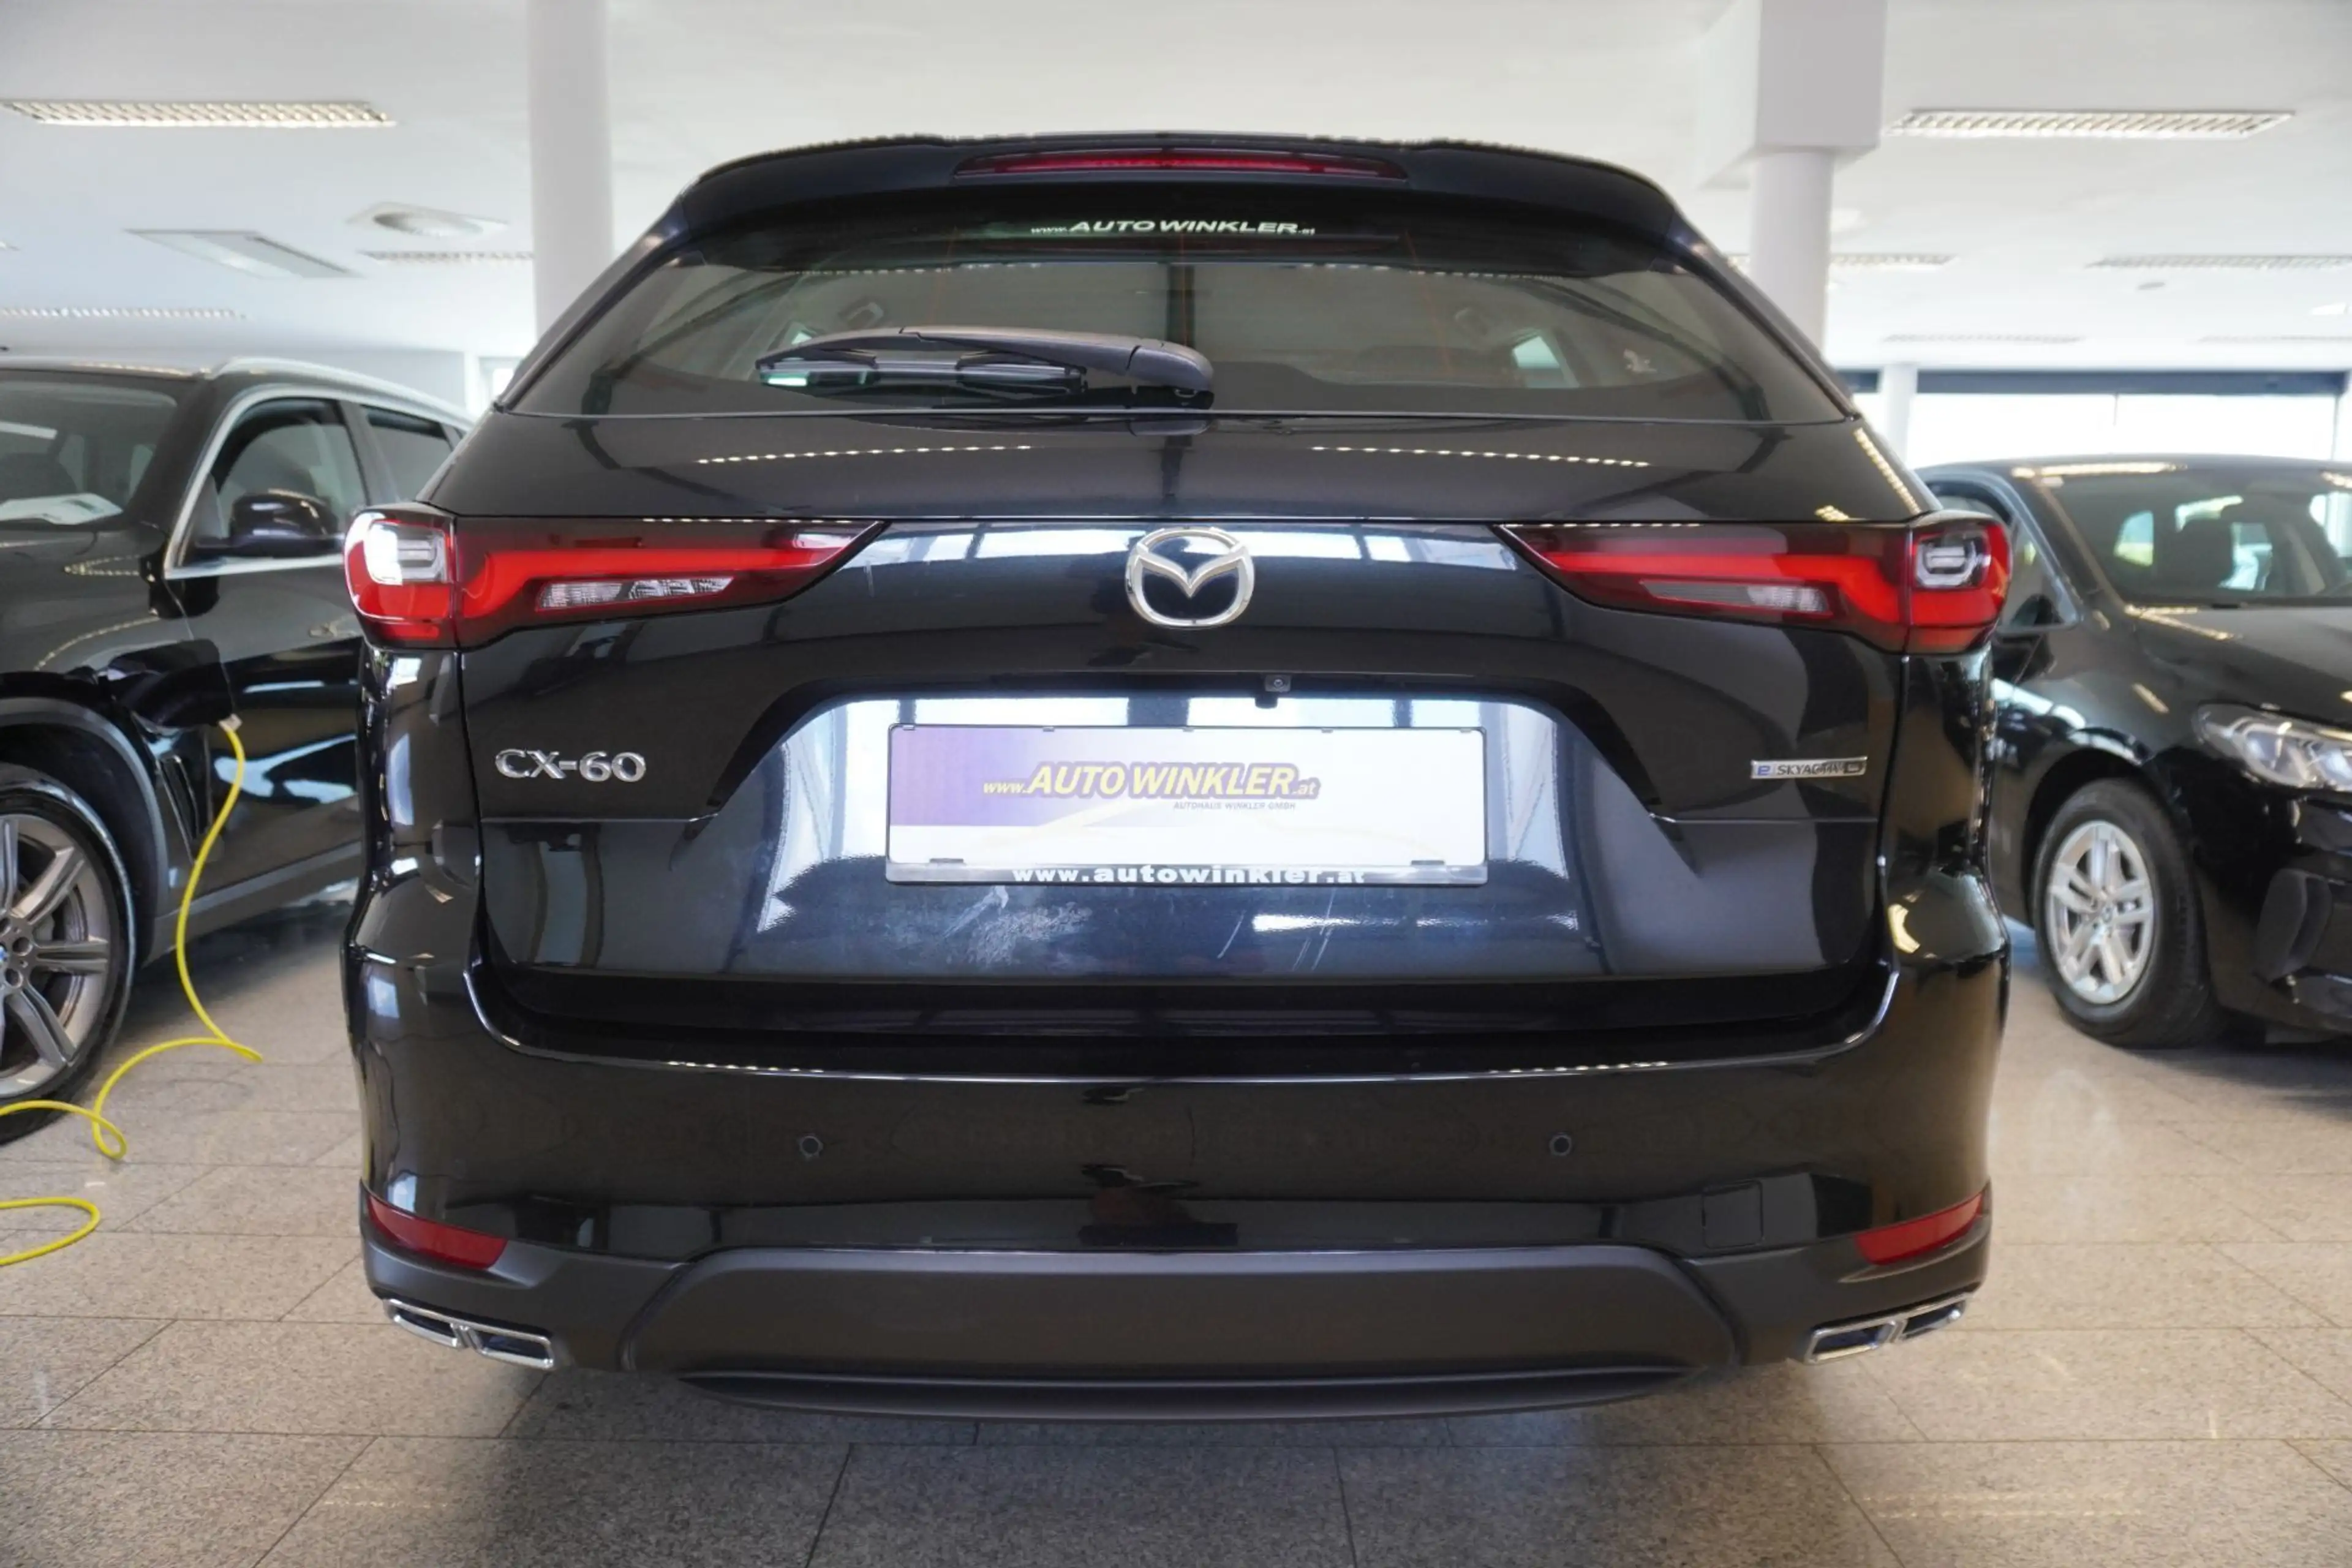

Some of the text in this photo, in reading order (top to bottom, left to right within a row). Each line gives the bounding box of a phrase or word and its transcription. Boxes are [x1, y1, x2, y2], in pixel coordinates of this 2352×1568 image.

[495, 748, 646, 782] CX-60
[1224, 801, 1265, 810] WINKLER
[1012, 864, 1366, 884] www.autowinkler.at
